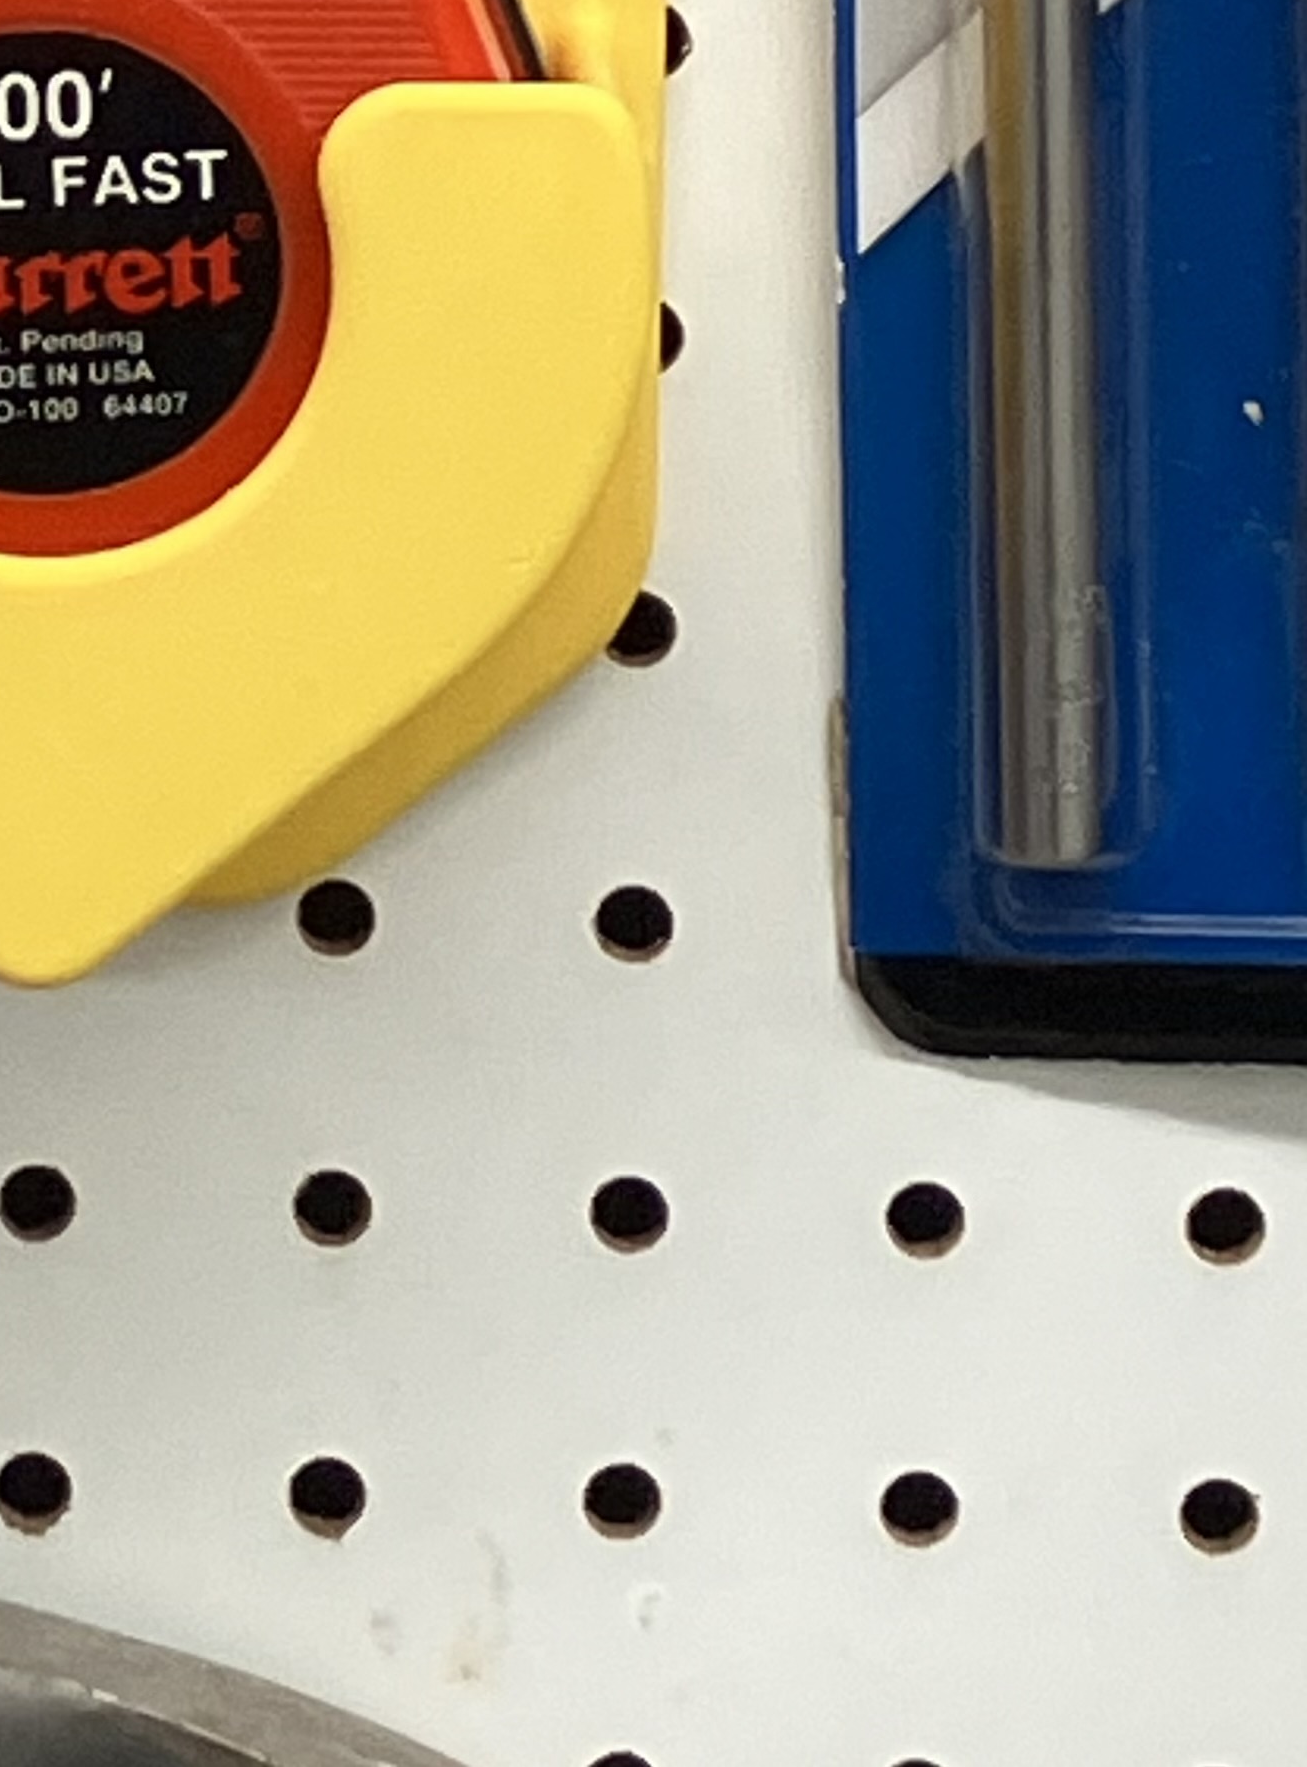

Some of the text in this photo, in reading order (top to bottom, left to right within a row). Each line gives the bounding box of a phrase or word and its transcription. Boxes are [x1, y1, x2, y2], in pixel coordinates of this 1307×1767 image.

[51, 149, 228, 206] FAST
[20, 329, 144, 355] Pending
[45, 363, 79, 385] IN
[88, 359, 156, 385] USA
